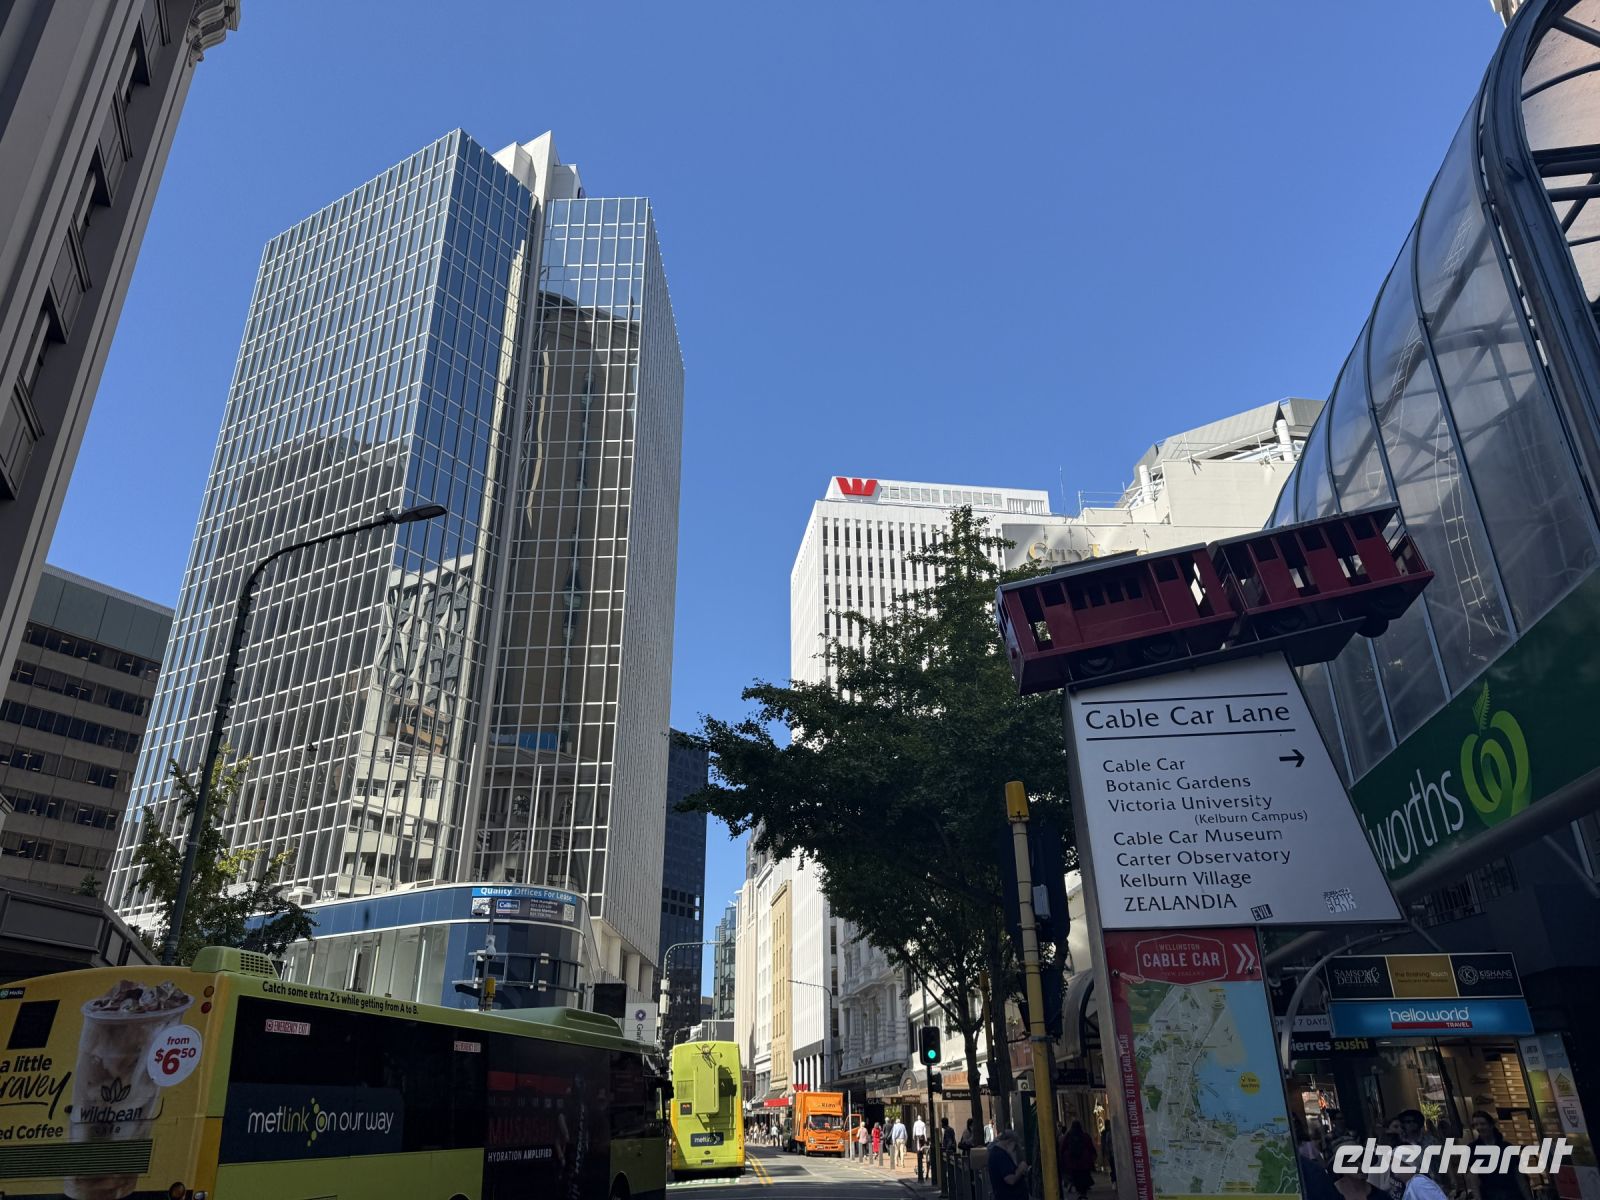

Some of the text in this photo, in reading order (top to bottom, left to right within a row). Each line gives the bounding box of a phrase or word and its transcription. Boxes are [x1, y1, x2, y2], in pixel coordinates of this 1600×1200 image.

[1085, 703, 1290, 730] Cable Car Lane
[1103, 757, 1185, 773] Cable Car
[1106, 775, 1251, 793] Botanic Gardens
[1108, 794, 1273, 812] Victoria University
[1194, 810, 1308, 826] (Kelburn Campus)
[1362, 768, 1464, 873] worths
[1113, 827, 1283, 846] Cable Car Museum
[1116, 849, 1291, 867] Carter Observatory
[1120, 871, 1252, 888] Kelburn Village
[514, 888, 542, 897] Offices
[543, 890, 555, 899] For
[556, 892, 573, 902] Lease
[1124, 893, 1238, 912] ZEALANDIA
[1251, 905, 1272, 920] EVIL
[1157, 943, 1201, 951] WELLINGTON
[1142, 952, 1221, 968] CABLE CAR
[1478, 969, 1513, 977] KISHANS
[262, 981, 286, 995] Catch
[287, 987, 308, 998] some
[309, 990, 329, 1001] extra
[341, 994, 359, 1006] while
[360, 998, 384, 1012] getting
[384, 1000, 400, 1011] from
[1389, 1006, 1470, 1021] helloworld
[167, 1036, 190, 1046] from
[1291, 1038, 1369, 1052] ierres sushi
[0, 1055, 53, 1072] a little
[1123, 1074, 1135, 1087] THE
[0, 1072, 72, 1119] ravey
[1126, 1089, 1136, 1099] TO
[247, 1105, 311, 1134] metlink
[339, 1110, 364, 1132] our
[366, 1110, 394, 1134] way
[1127, 1099, 1141, 1137] WELCOME
[0, 1123, 63, 1140] ed Coffee
[487, 1148, 553, 1163] HYDRATION AMPLIFIED
